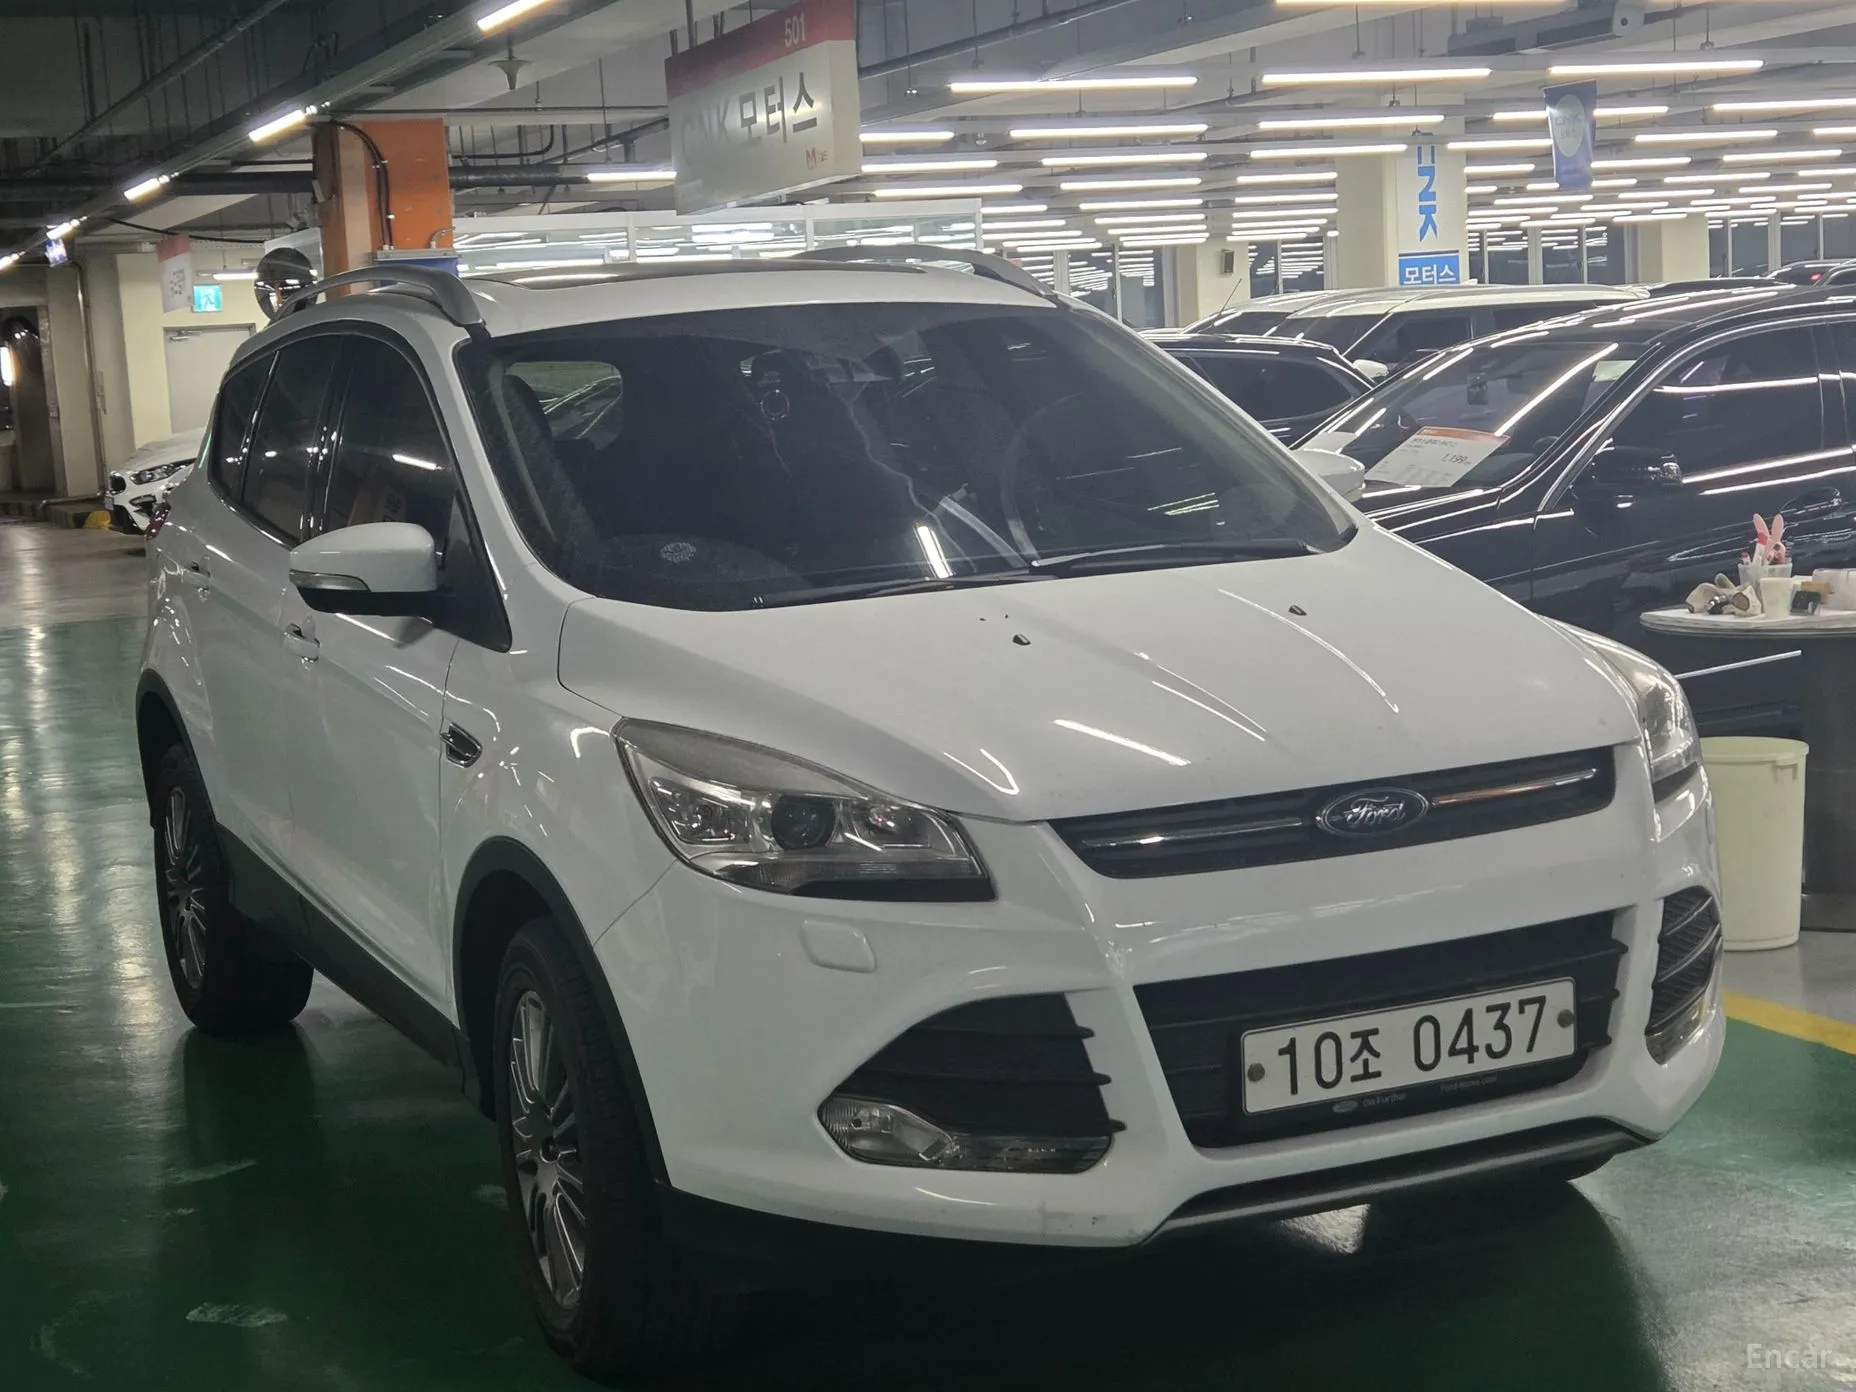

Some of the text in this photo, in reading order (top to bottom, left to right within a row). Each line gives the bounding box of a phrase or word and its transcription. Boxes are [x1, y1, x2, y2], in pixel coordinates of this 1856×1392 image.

[784, 12, 807, 47] 501
[1403, 264, 1456, 285] 모터스
[1344, 796, 1405, 828] Ford
[1277, 995, 1547, 1096] 10조 0437
